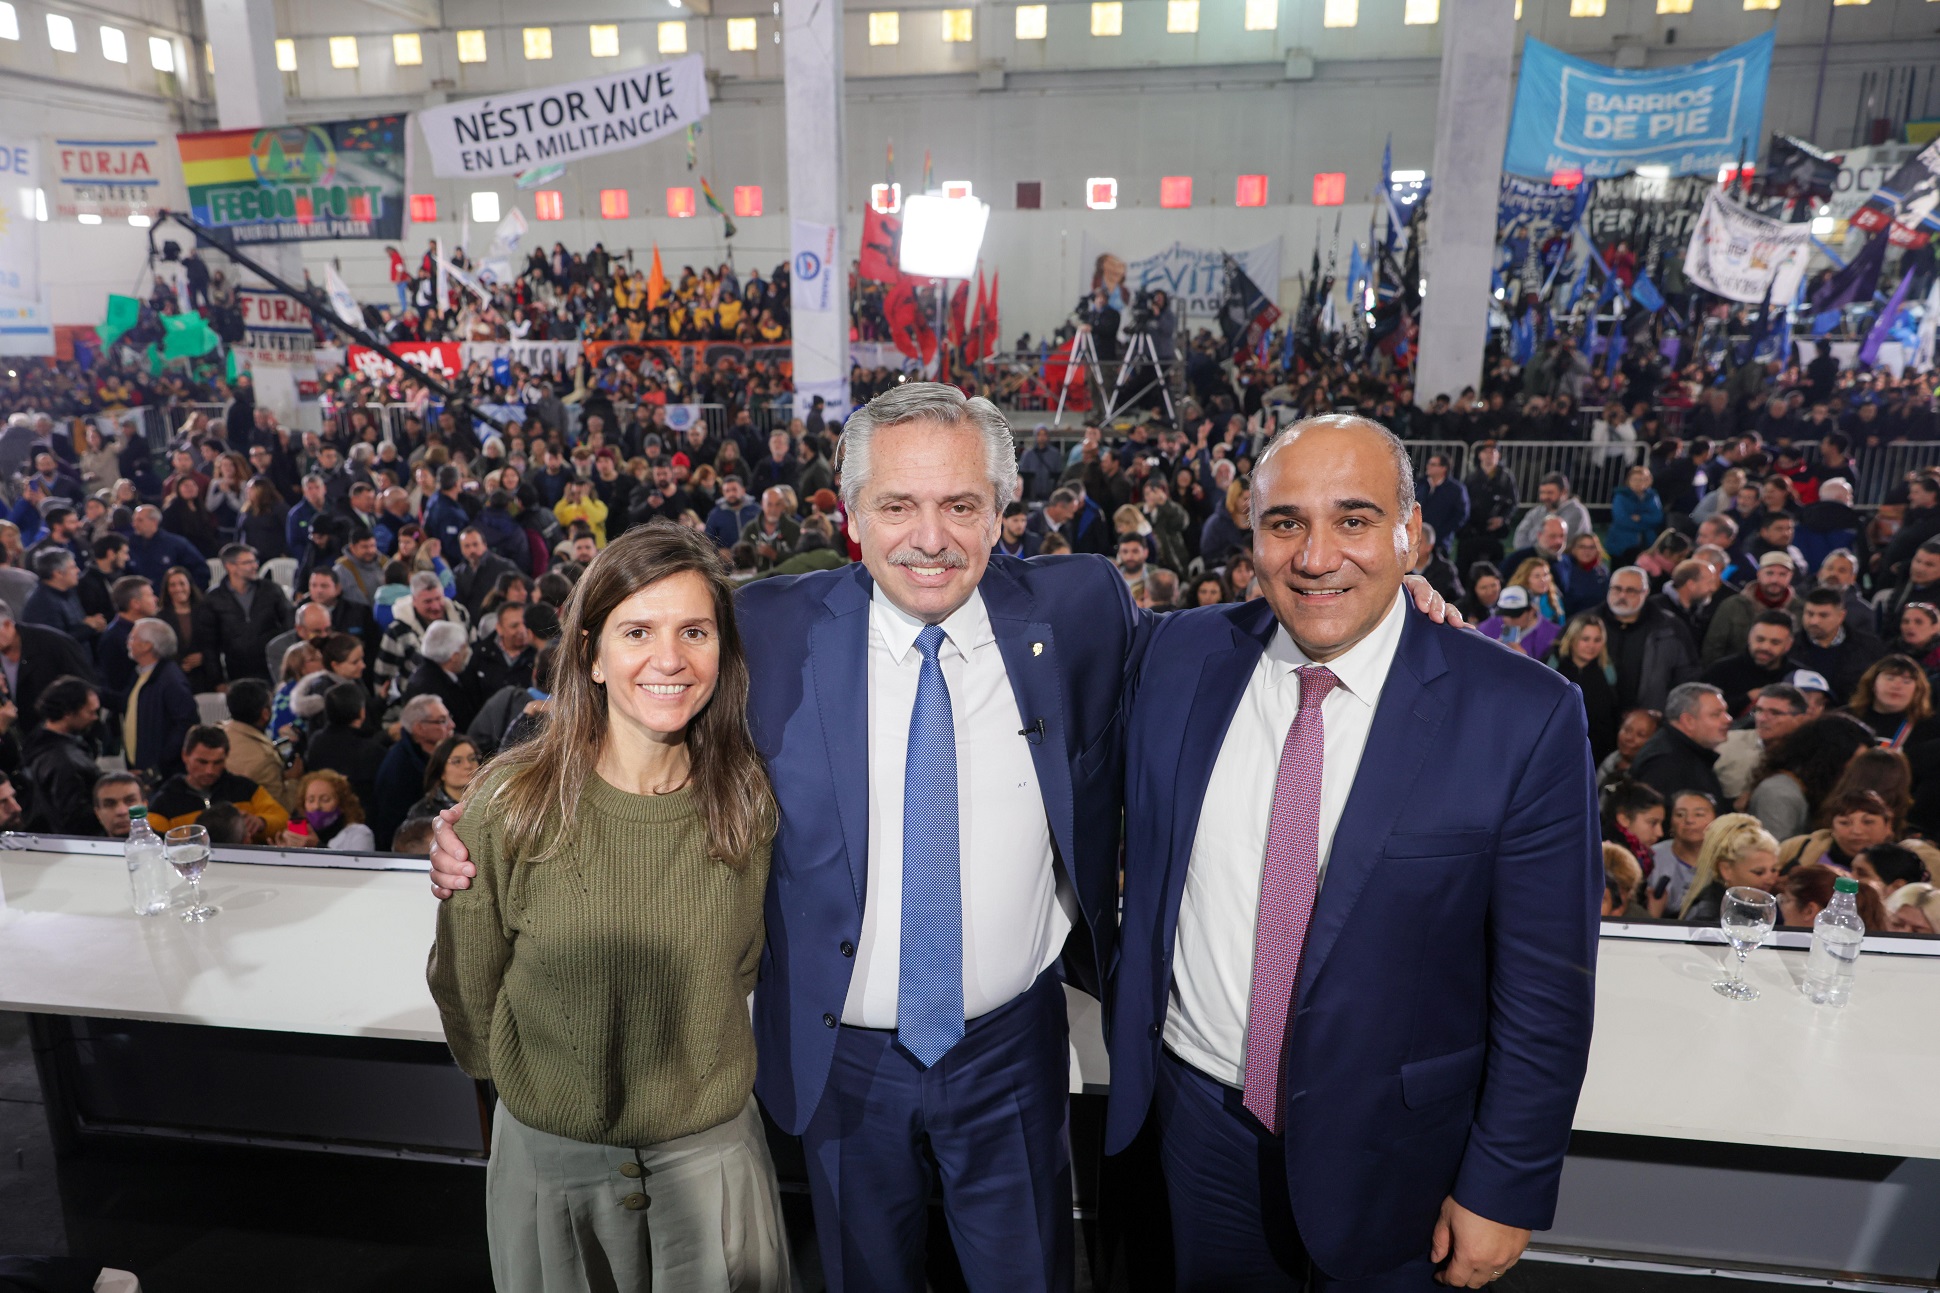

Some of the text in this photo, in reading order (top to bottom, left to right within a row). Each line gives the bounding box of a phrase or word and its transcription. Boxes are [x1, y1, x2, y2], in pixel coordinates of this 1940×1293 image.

[453, 67, 675, 144] NÉSTOR VIVE
[1585, 85, 1715, 113] BARRIOS
[461, 103, 679, 171] EN LA MILITANCIA
[1583, 107, 1713, 140] DE PIE
[61, 150, 150, 175] FORJA
[1139, 263, 1247, 294] EVIT
[241, 297, 313, 324] FORJA
